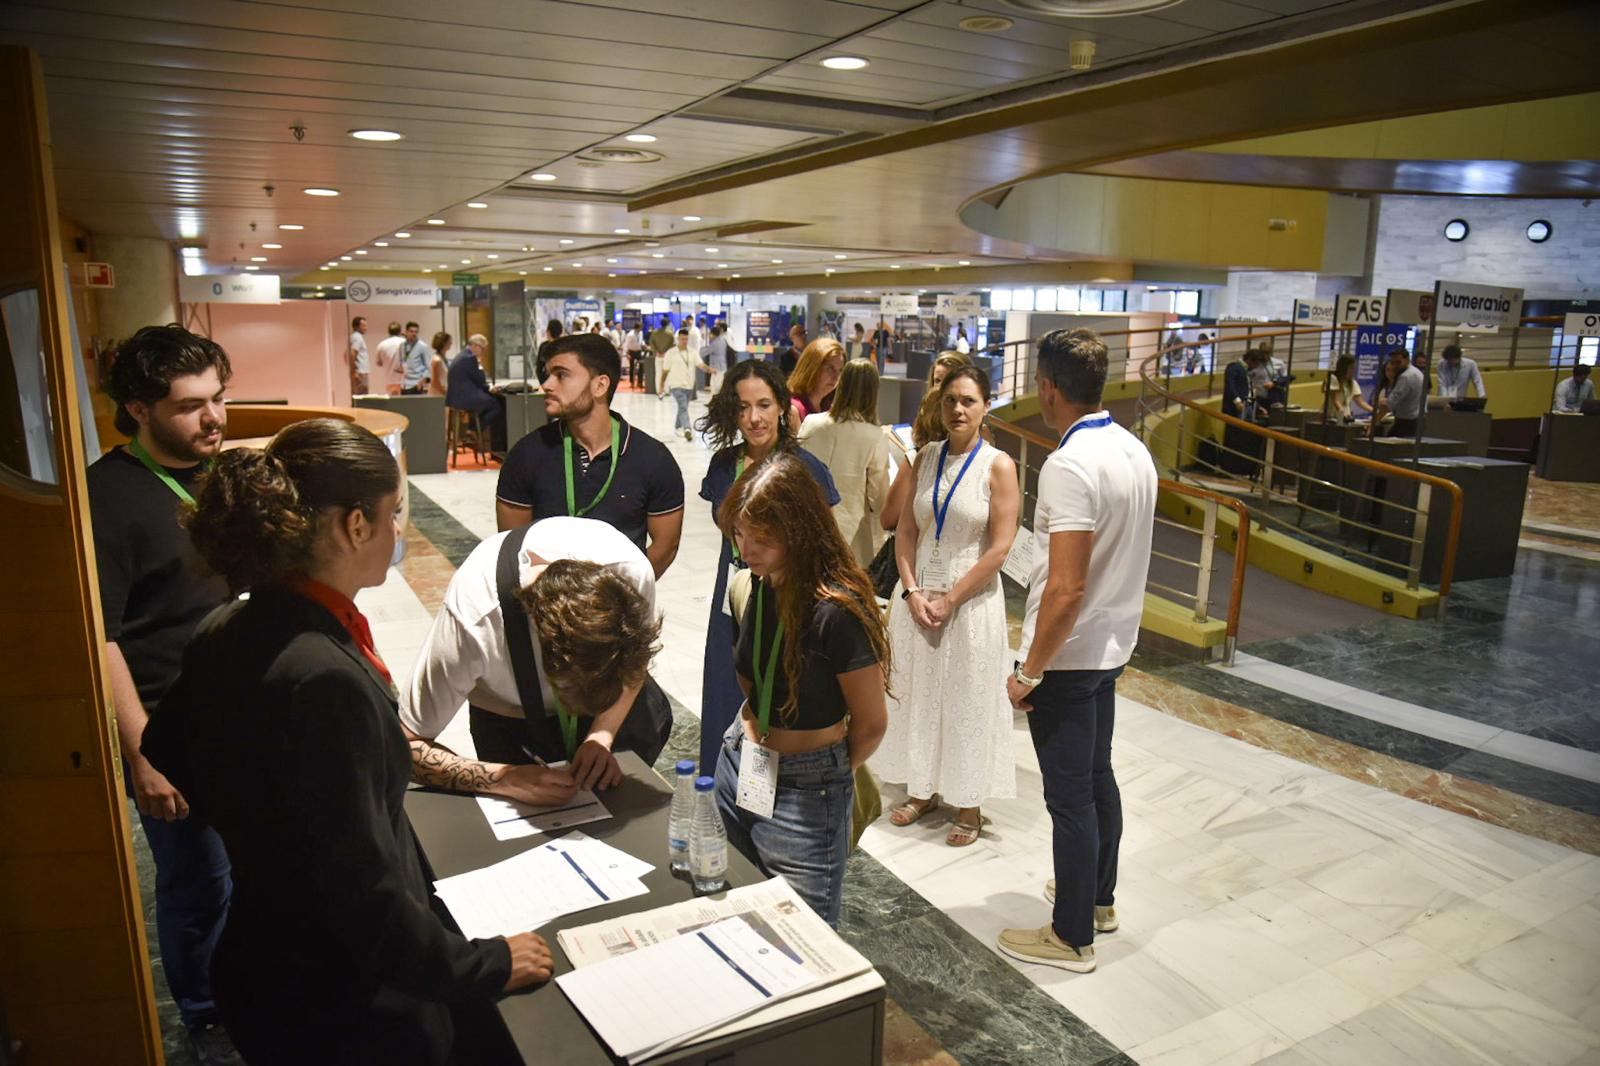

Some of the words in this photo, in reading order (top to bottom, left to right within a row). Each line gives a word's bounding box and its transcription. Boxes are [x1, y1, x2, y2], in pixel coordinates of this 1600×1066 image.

[376, 287, 432, 296] SongsWallet
[1345, 299, 1382, 322] FAS
[1585, 316, 1600, 327] O
